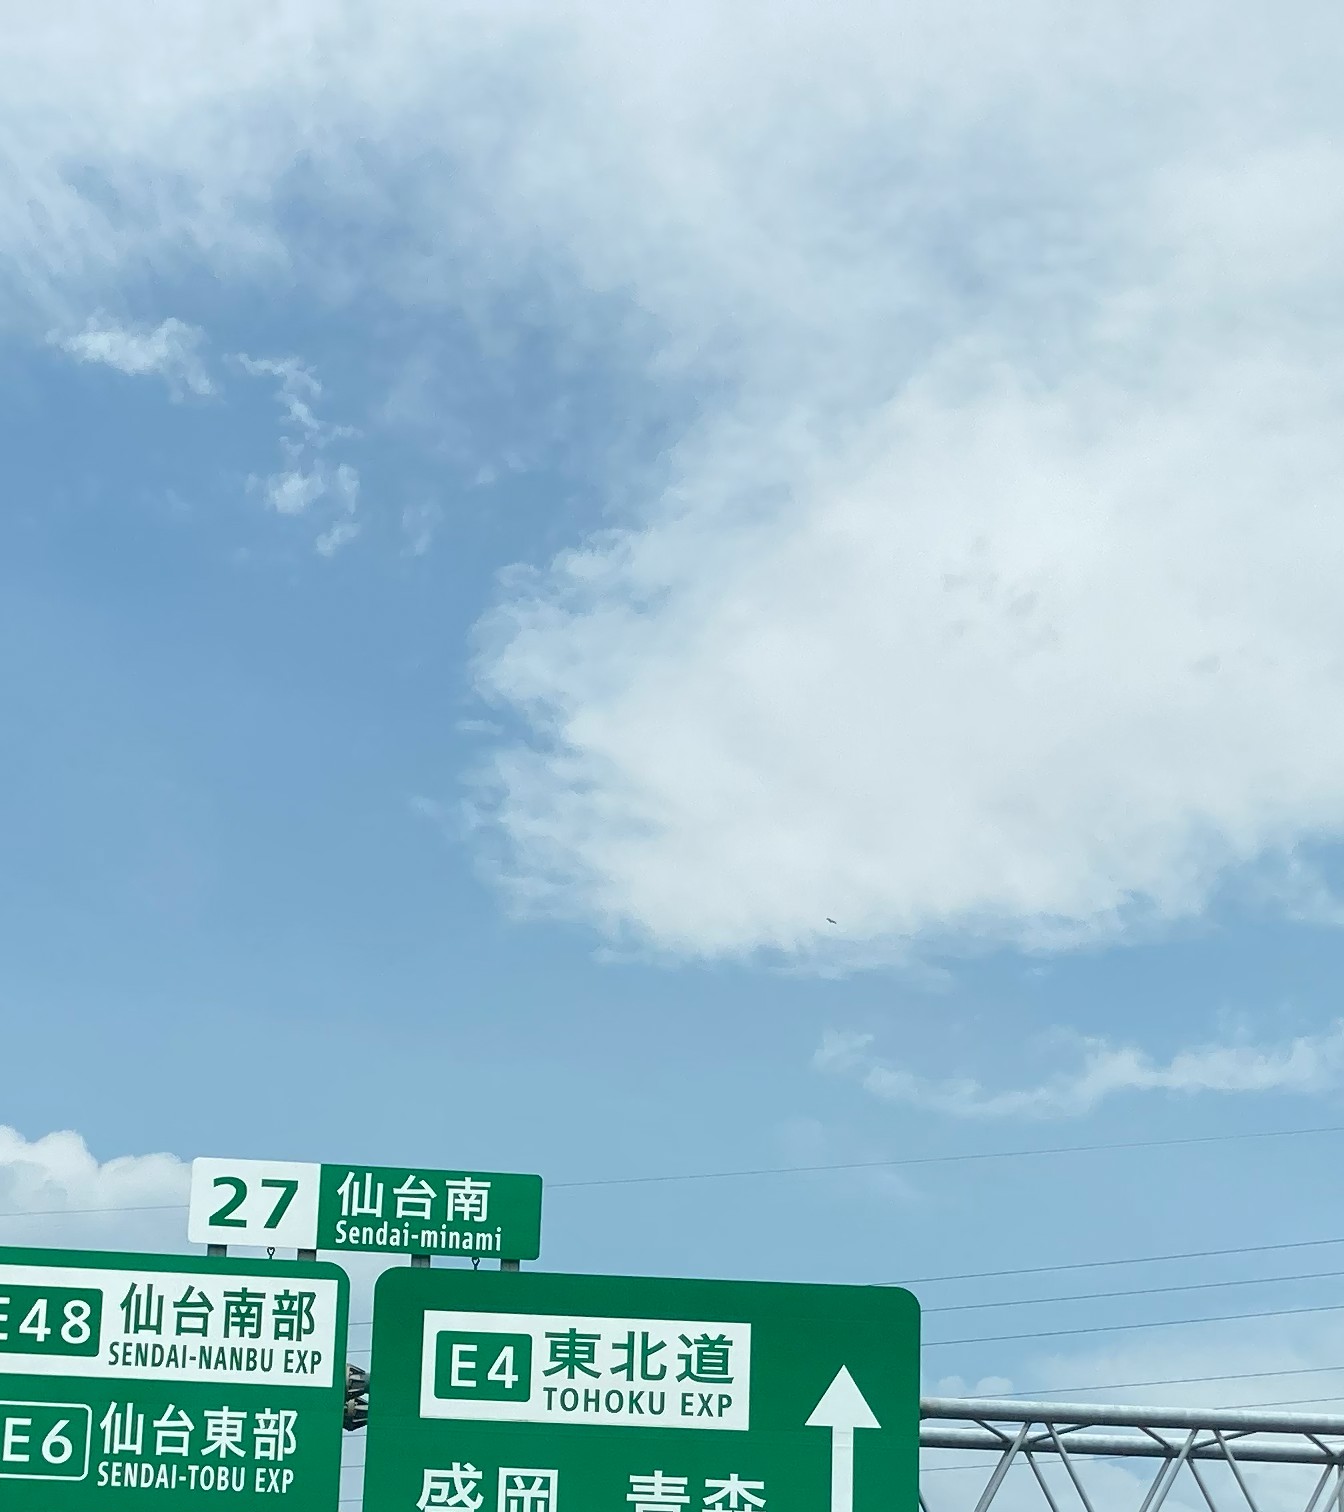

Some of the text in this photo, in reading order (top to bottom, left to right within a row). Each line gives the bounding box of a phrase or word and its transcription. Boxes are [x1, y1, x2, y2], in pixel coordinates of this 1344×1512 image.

[208, 1176, 299, 1229] 27
[336, 1171, 492, 1223] 仙台南
[335, 1220, 503, 1252] Sendai-minami
[119, 1281, 318, 1344] 仙台南部
[107, 1341, 323, 1376] SENDAI-NANBU EXP
[449, 1342, 520, 1390] E4
[541, 1326, 736, 1387] 東北道
[542, 1386, 734, 1418] TOHOKU EXP
[0, 1416, 75, 1465] E6
[99, 1402, 299, 1464] 仙台東部
[97, 1462, 295, 1496] SENDAI-TOBU EXP
